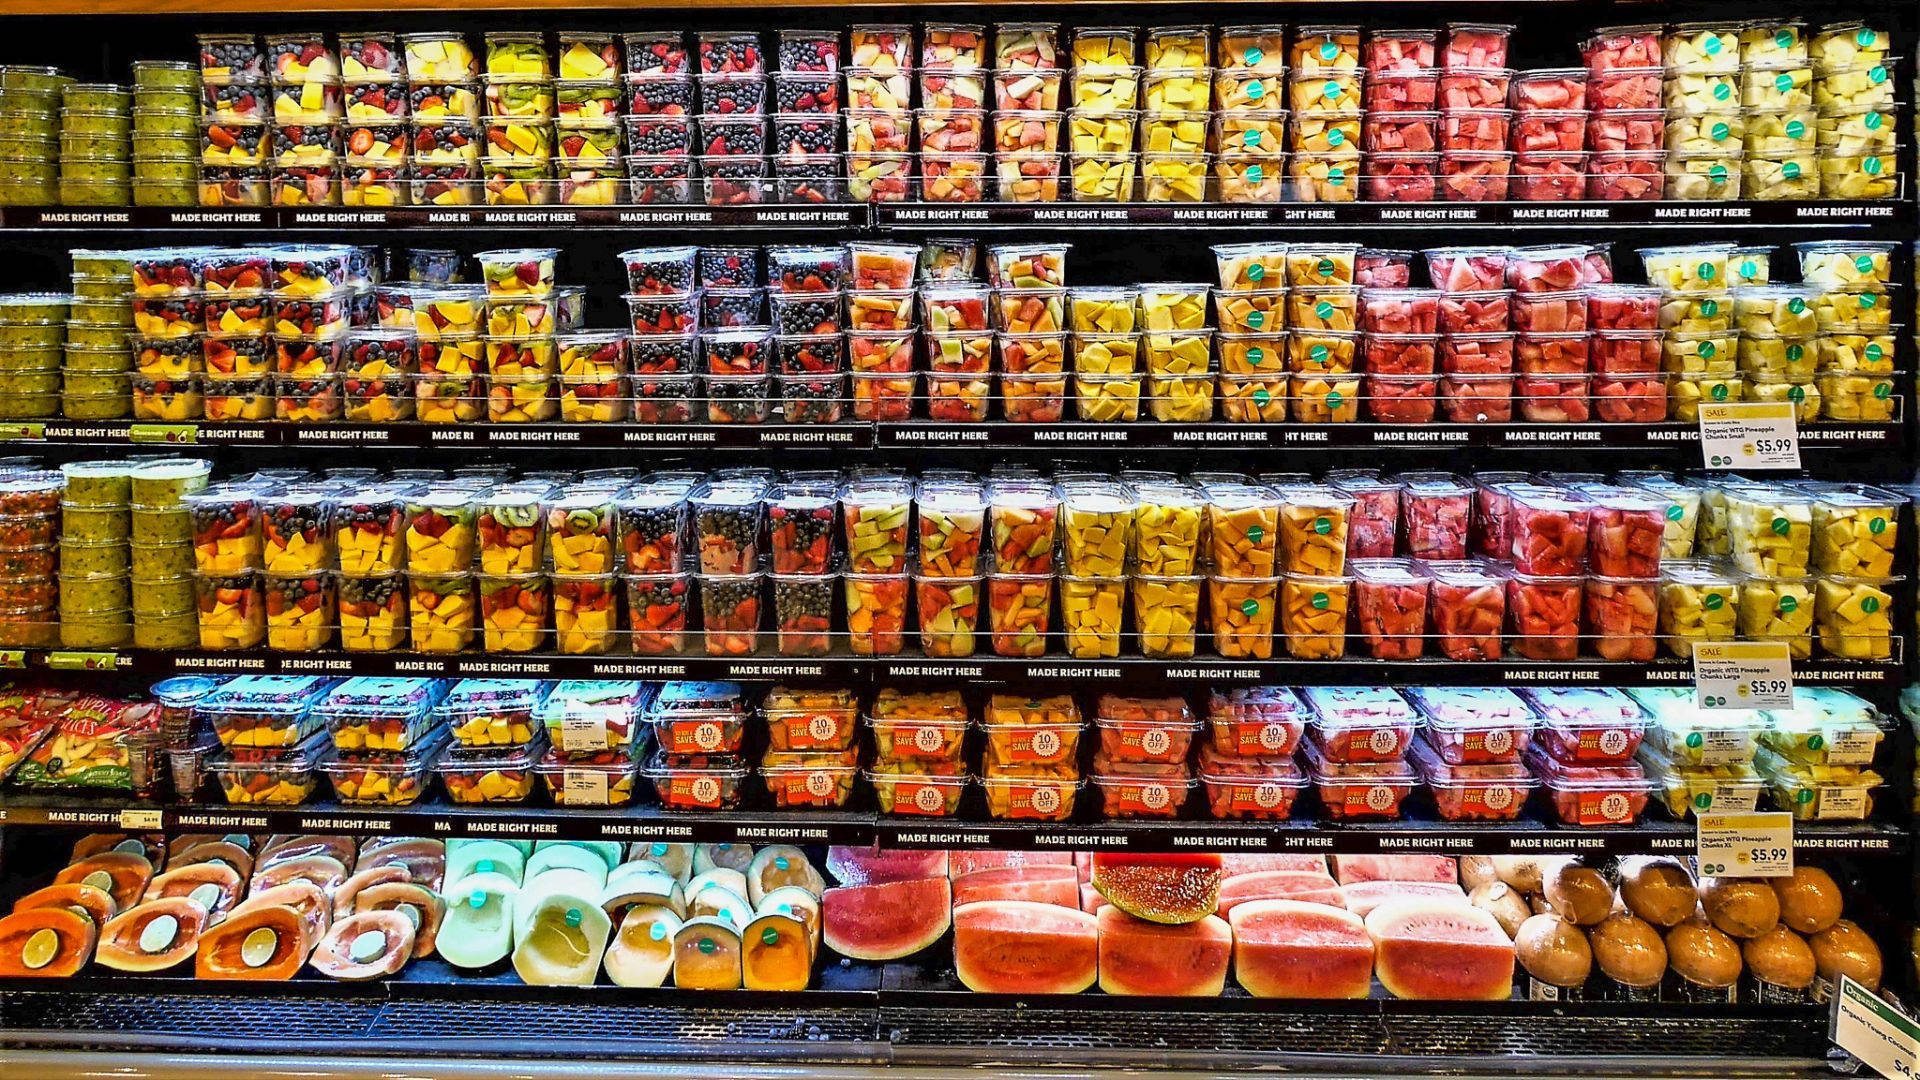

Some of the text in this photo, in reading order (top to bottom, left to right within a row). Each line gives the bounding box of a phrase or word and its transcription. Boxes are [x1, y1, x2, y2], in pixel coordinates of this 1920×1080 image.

[1066, 211, 1100, 219] RIGHT
[1654, 209, 1688, 217] MADE
[1688, 209, 1723, 217] RIGHT
[1796, 208, 1829, 216] MADE
[1829, 208, 1864, 216] RIGHT
[619, 213, 713, 221] MADE RIGHT HERE
[1705, 409, 1727, 417] SALE
[489, 432, 520, 440] MADE
[1034, 432, 1128, 440] MADE RIGHT HERE
[1406, 432, 1440, 440] RIGHT
[1441, 432, 1469, 440] HERE
[1757, 439, 1791, 452] $5.99
[206, 659, 238, 667] RIGHT
[459, 663, 490, 671] MADE
[523, 664, 550, 672] HERE
[593, 665, 624, 673] MADE
[1751, 681, 1786, 693] $5.99
[814, 720, 827, 728] 10
[921, 731, 934, 739] 10
[1266, 728, 1278, 736] 10
[676, 736, 693, 744] SAVE
[1038, 735, 1050, 743] 10
[1149, 733, 1161, 741] 10
[1377, 733, 1388, 741] 10
[1491, 733, 1503, 741] 10
[1606, 733, 1619, 741] 10
[1122, 737, 1140, 746] SAVE
[1351, 741, 1368, 749] SAVE
[1465, 742, 1482, 750] SAVE
[698, 782, 710, 790] 10
[673, 787, 691, 795] SAVE
[178, 816, 209, 824] MADE
[209, 817, 241, 825] RIGHT
[332, 820, 364, 828] RIGHT
[364, 821, 391, 829] HERE
[467, 823, 558, 832] MADE RIGHT HERE
[601, 826, 632, 834] MADE
[665, 827, 693, 835] HERE
[897, 834, 928, 842] MADE
[1035, 836, 1066, 844] MADE
[1067, 836, 1100, 844] RIGHT
[1446, 839, 1474, 847] HERE
[1510, 839, 1605, 847] MADE RIGHT HERE
[1751, 849, 1786, 862] $5.99
[1846, 985, 1879, 1011] Organic
[1842, 1006, 1867, 1026] Organic
